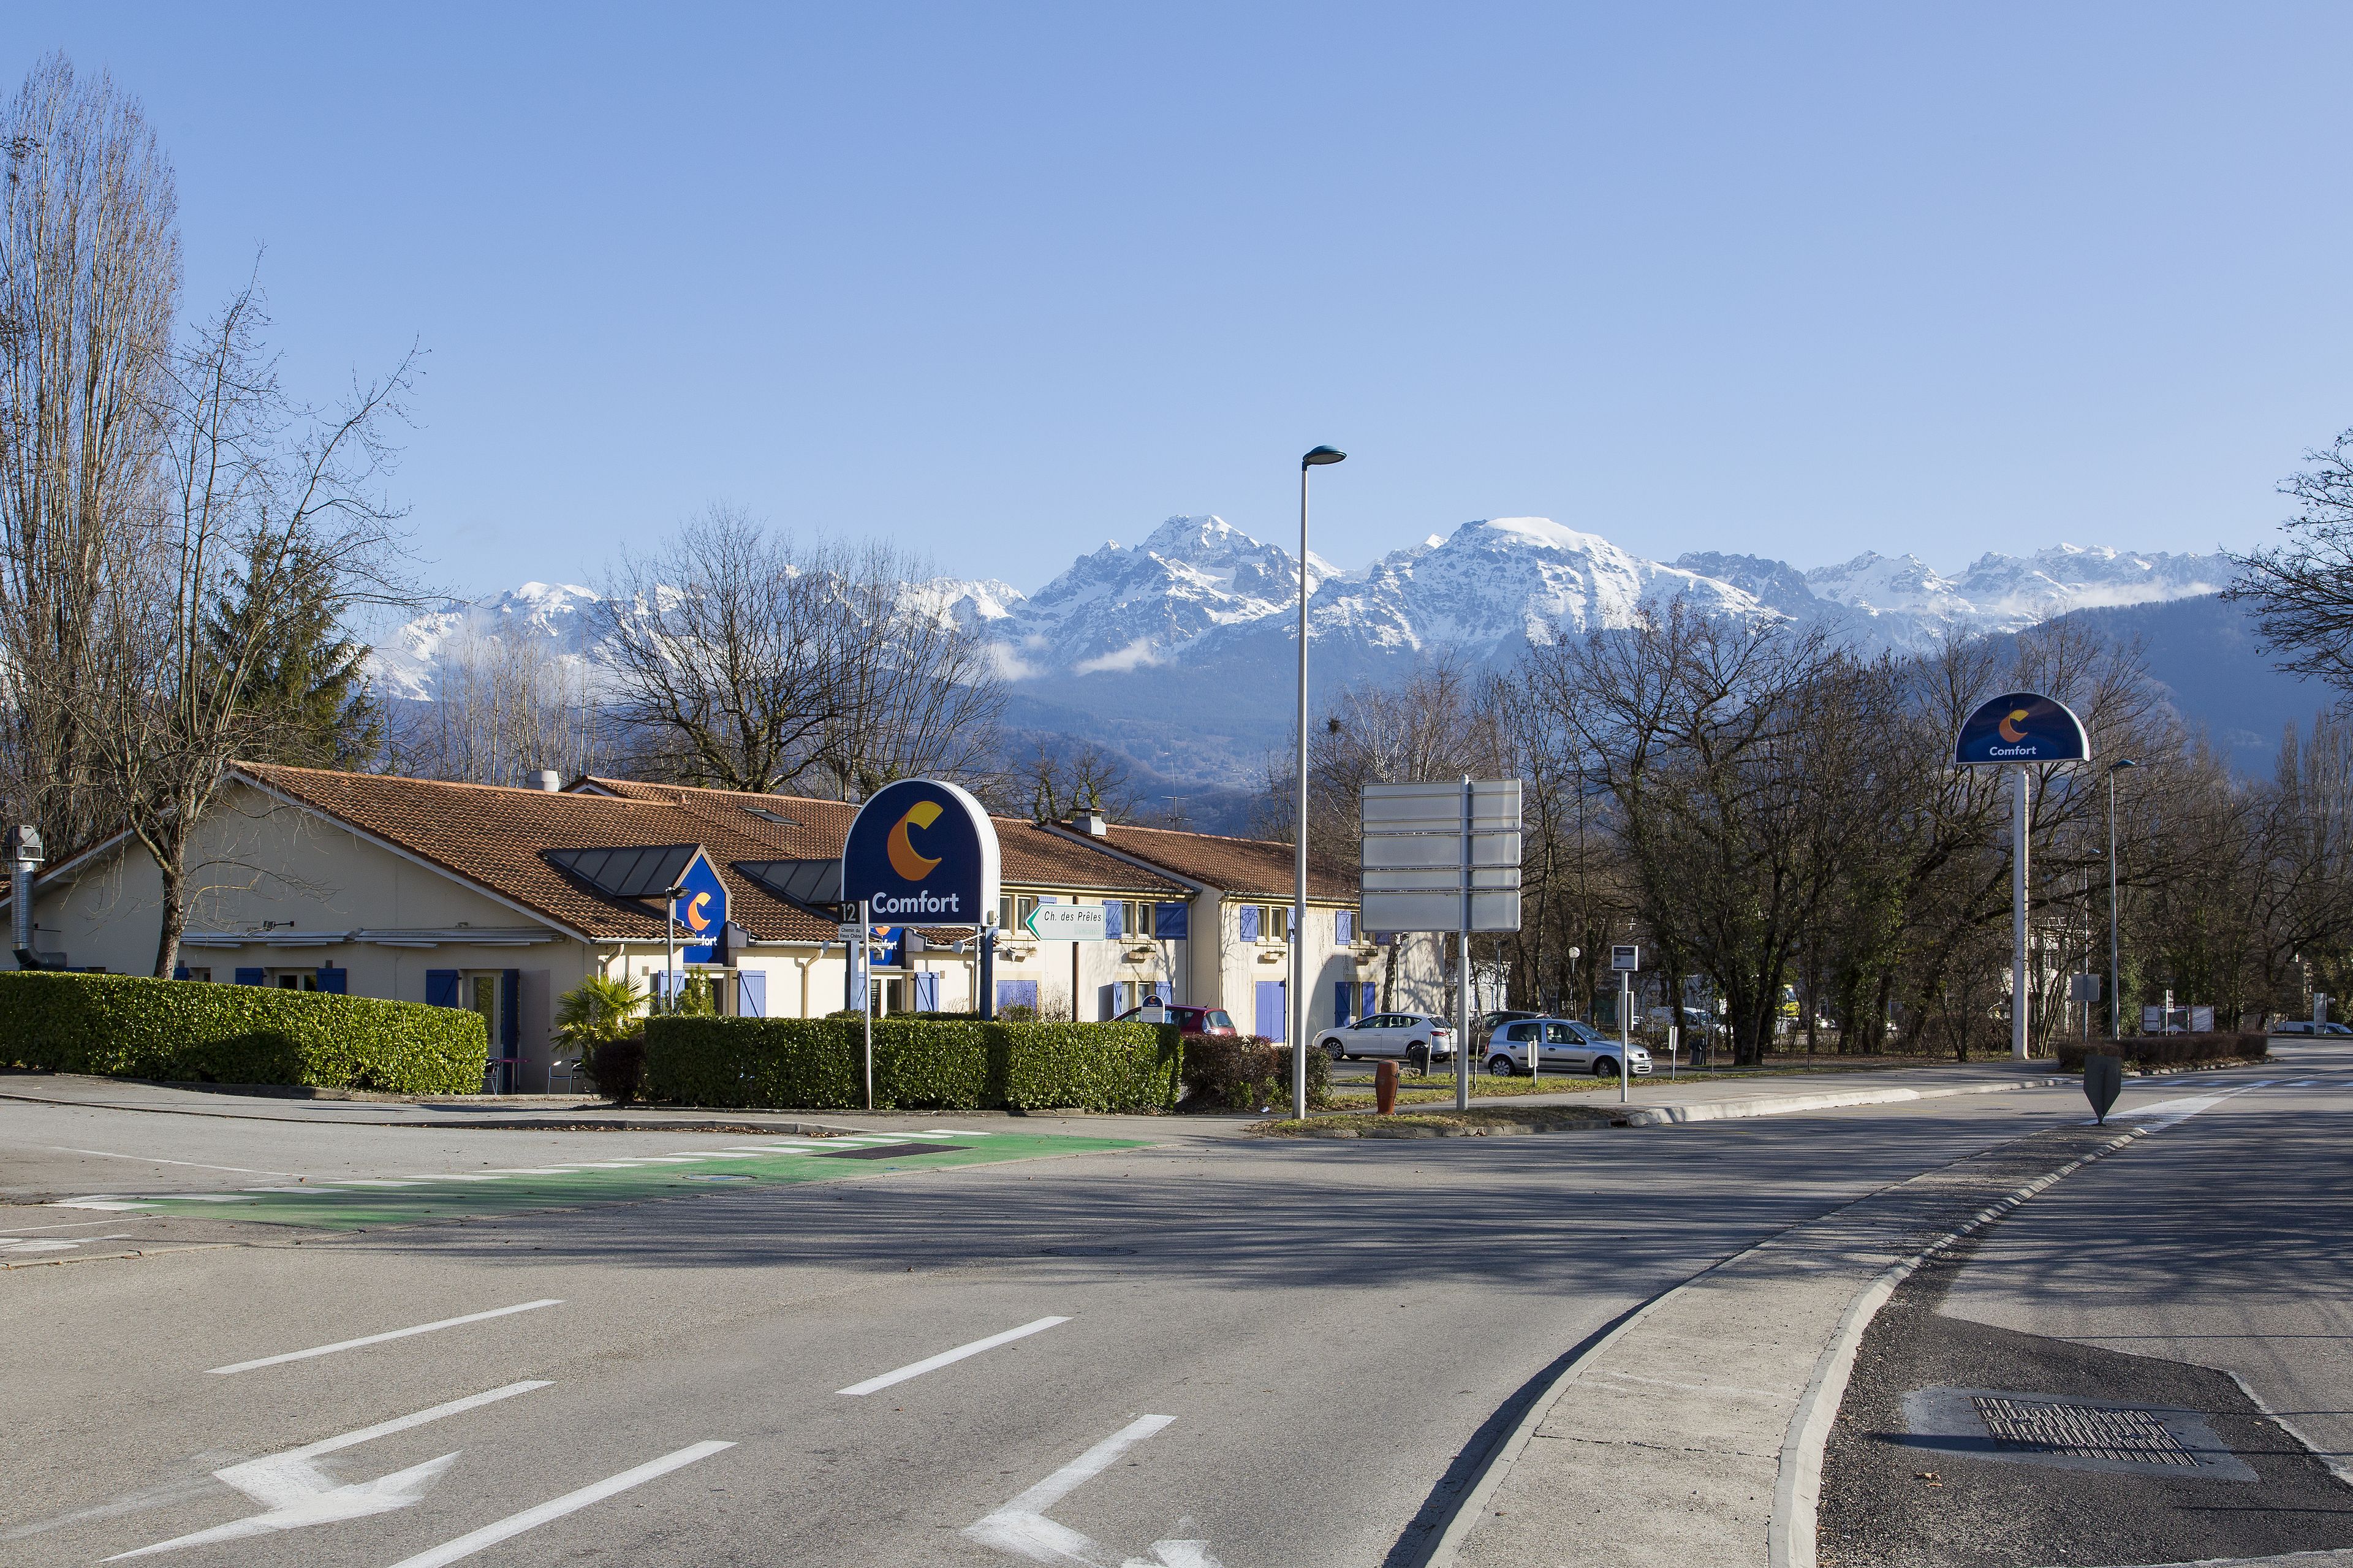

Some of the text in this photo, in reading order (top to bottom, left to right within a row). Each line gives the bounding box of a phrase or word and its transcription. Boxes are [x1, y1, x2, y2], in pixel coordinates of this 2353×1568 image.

[1990, 746, 2037, 756] Comfort
[873, 890, 959, 913] Comfort
[841, 903, 856, 922] 12
[1044, 911, 1101, 922] Ch. des Prêles
